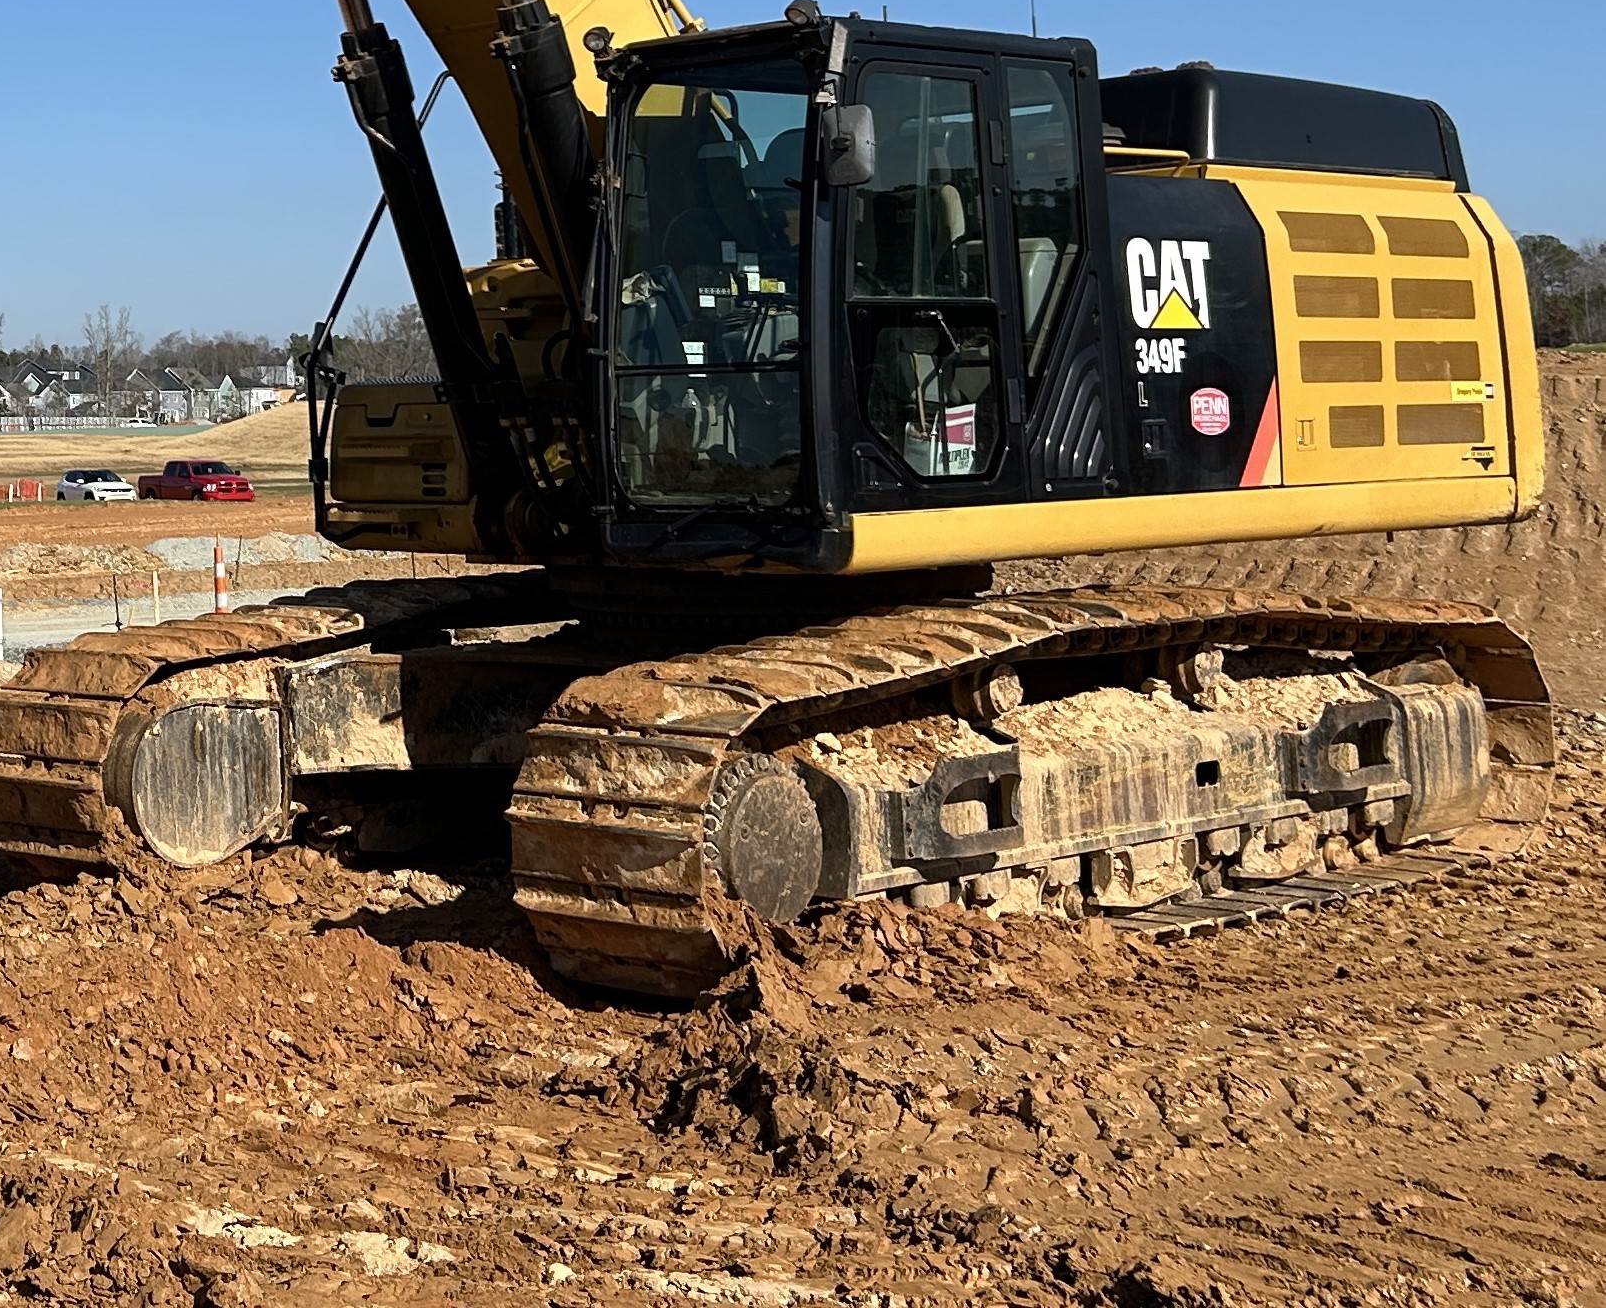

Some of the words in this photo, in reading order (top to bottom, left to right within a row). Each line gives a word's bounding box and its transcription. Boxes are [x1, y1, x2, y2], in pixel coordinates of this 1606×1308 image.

[1126, 237, 1211, 329] CAT
[1135, 337, 1187, 374] 349F
[1194, 396, 1228, 415] PENN
